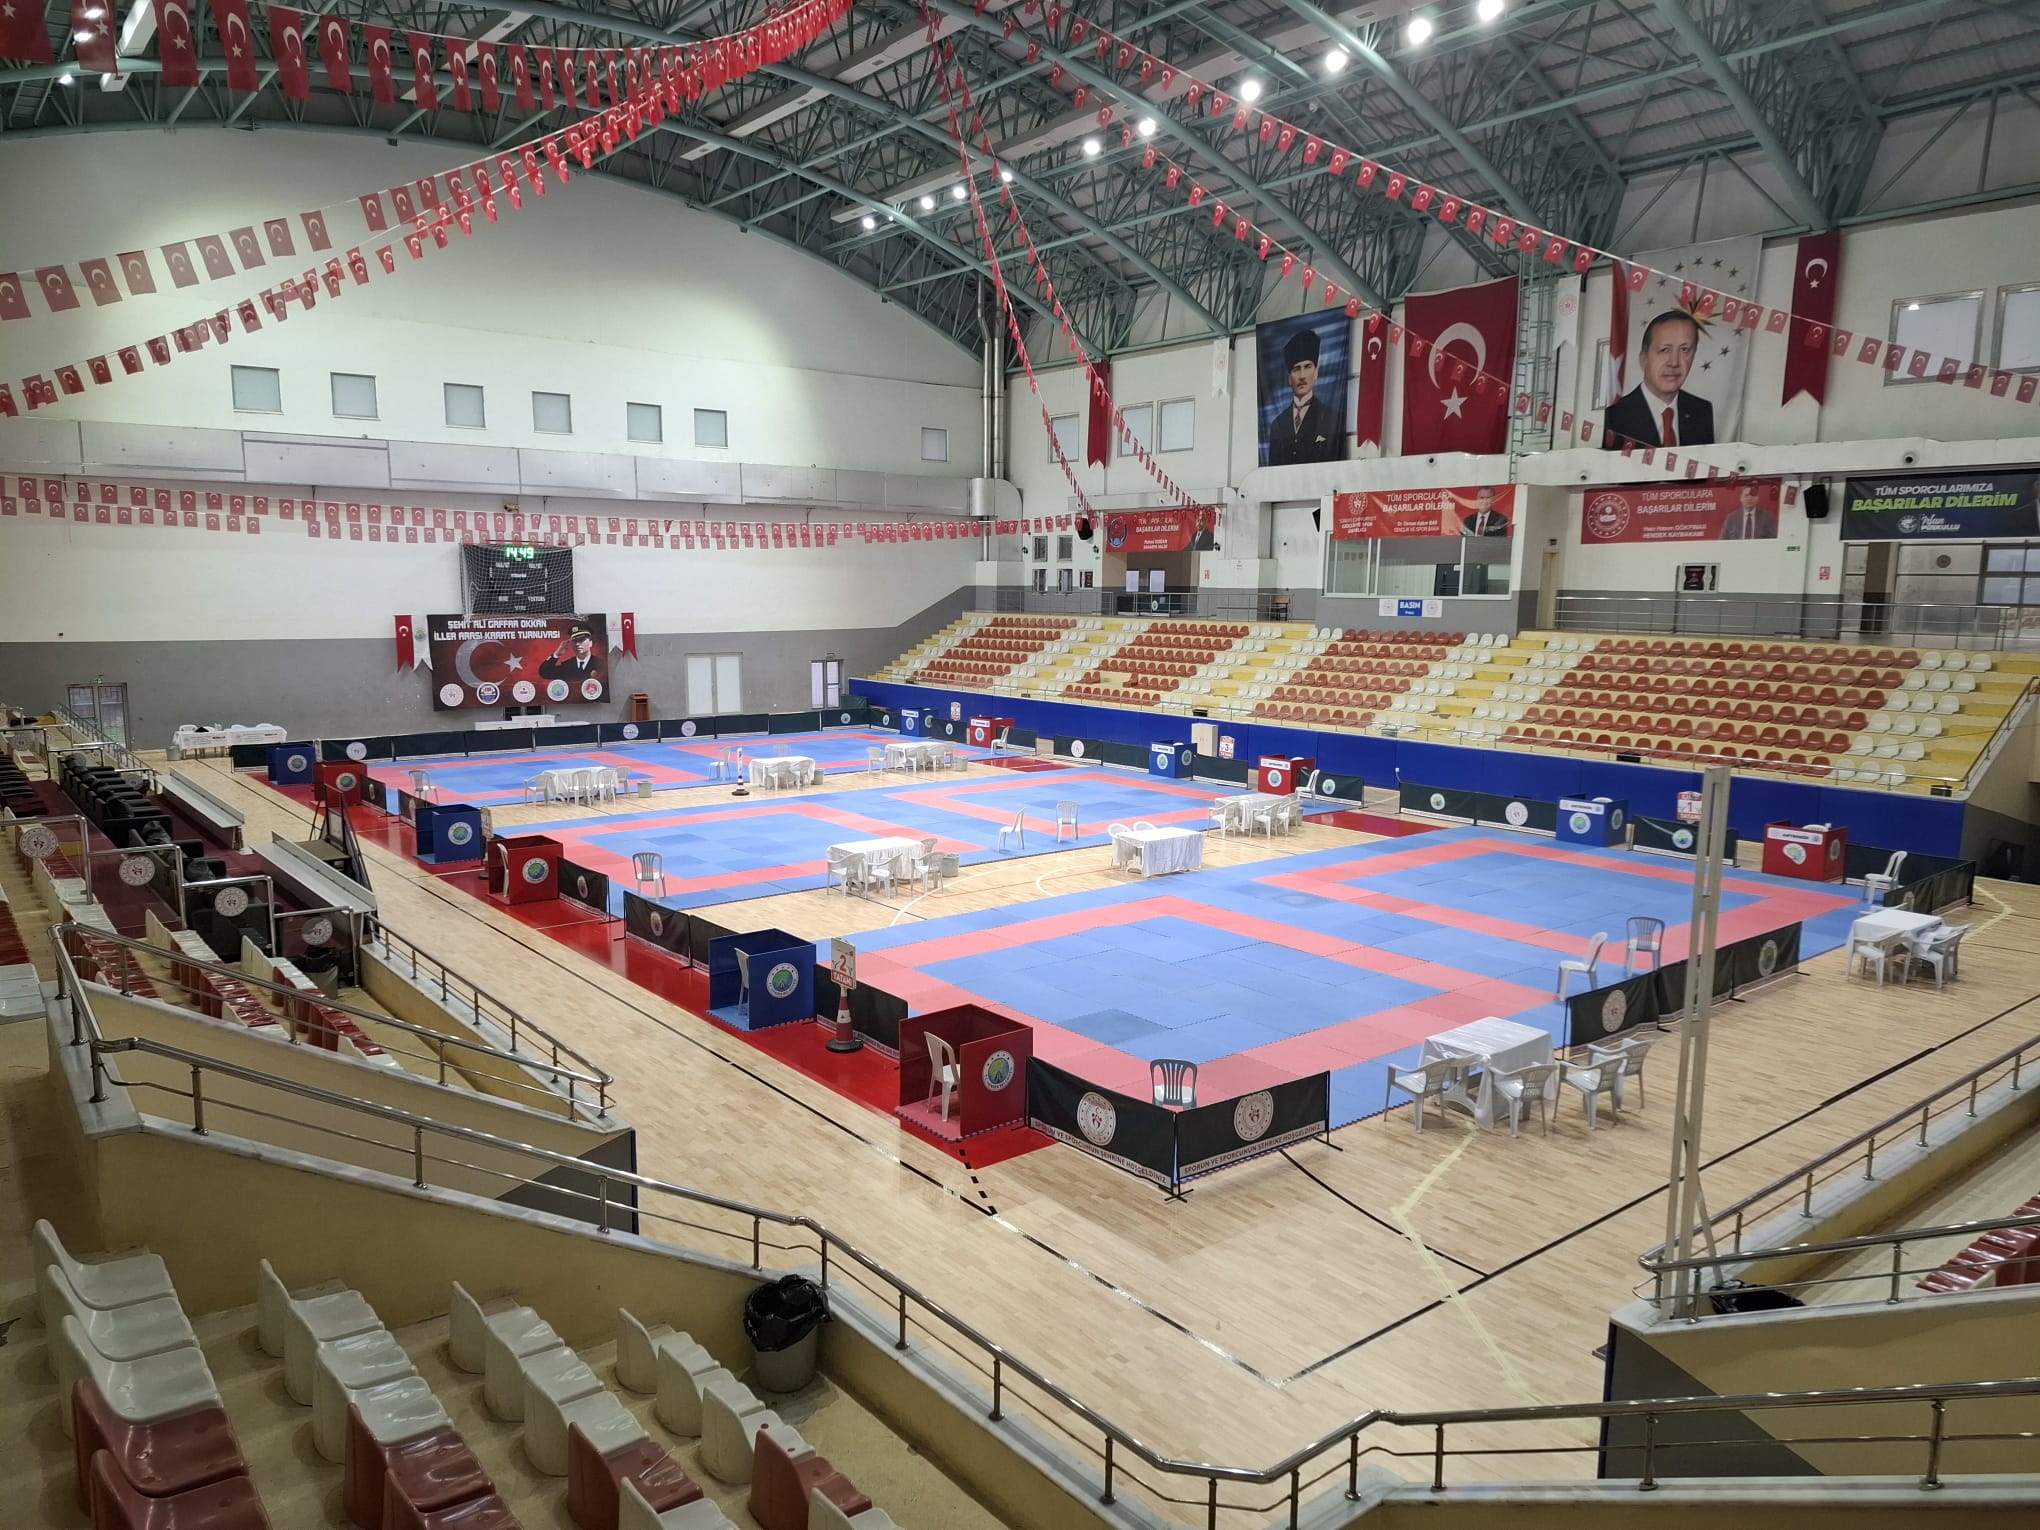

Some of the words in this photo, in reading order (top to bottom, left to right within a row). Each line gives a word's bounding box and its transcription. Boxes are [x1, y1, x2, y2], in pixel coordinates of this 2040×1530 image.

[1875, 485, 1898, 496] TÜM
[1898, 482, 1994, 495] SPORCULARIMIZA
[1382, 502, 1424, 514] BAŞARILAR
[1637, 503, 1682, 515] BAŞARILAR
[1851, 497, 1943, 513] BAŞARILAR
[1945, 492, 2018, 508] DİLERİM
[485, 631, 516, 640] KARATE
[840, 954, 847, 973] 2
[1184, 1161, 1210, 1175] SPORUN
[1210, 1158, 1220, 1167] VE
